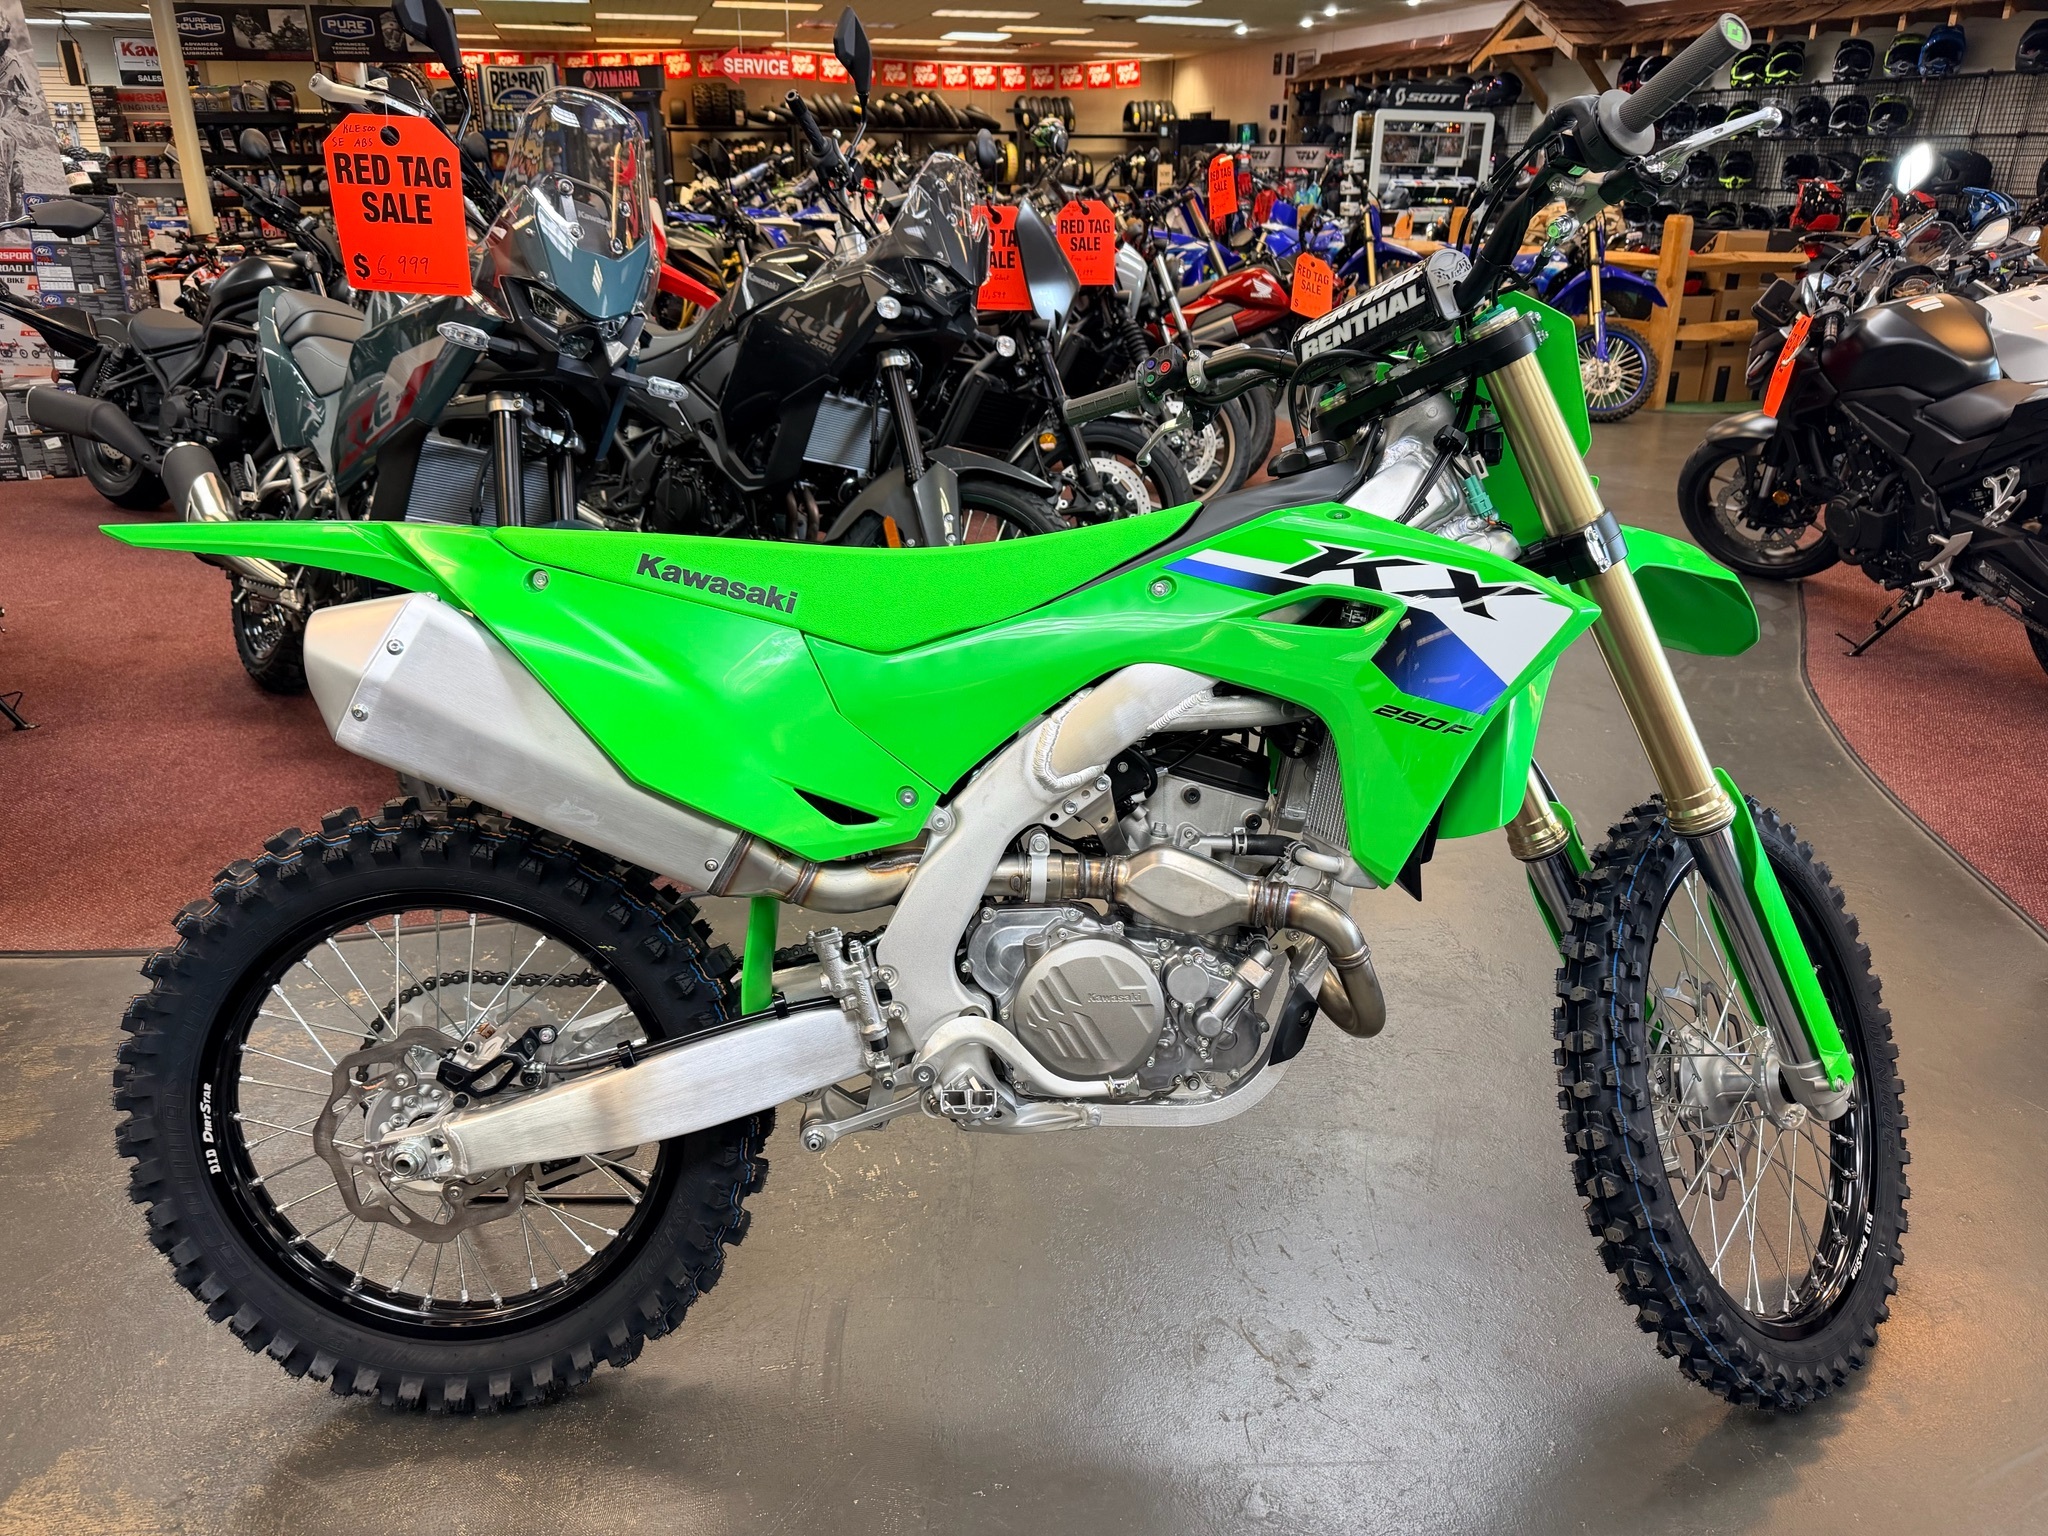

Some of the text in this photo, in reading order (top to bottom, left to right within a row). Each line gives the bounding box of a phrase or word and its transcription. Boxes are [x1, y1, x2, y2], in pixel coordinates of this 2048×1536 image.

[327, 20, 366, 29] PURE
[723, 58, 789, 75] SERVICE
[595, 70, 640, 87] YAMAHA
[1406, 92, 1460, 103] SCOTT
[332, 138, 374, 148] SE ABS
[333, 152, 452, 189] RED TAG
[1213, 180, 1228, 193] SALE
[361, 191, 433, 225] SALE
[1060, 219, 1110, 234] RED TAG
[1070, 237, 1101, 252] SALE
[353, 253, 430, 280] $ 6,999
[989, 251, 1016, 269] ALE
[7, 277, 25, 285] BIKE
[747, 271, 780, 291] Kawasaki
[1297, 264, 1330, 285] RED TAG
[1301, 280, 1321, 295] SALE
[778, 306, 843, 344] KLE
[1302, 285, 1426, 363] RENTHAL
[810, 337, 837, 353] 500
[636, 553, 798, 614] Kawasaki
[1279, 546, 1546, 621] KX
[1372, 704, 1474, 736] 250F
[1087, 992, 1142, 1003] Kawasaki
